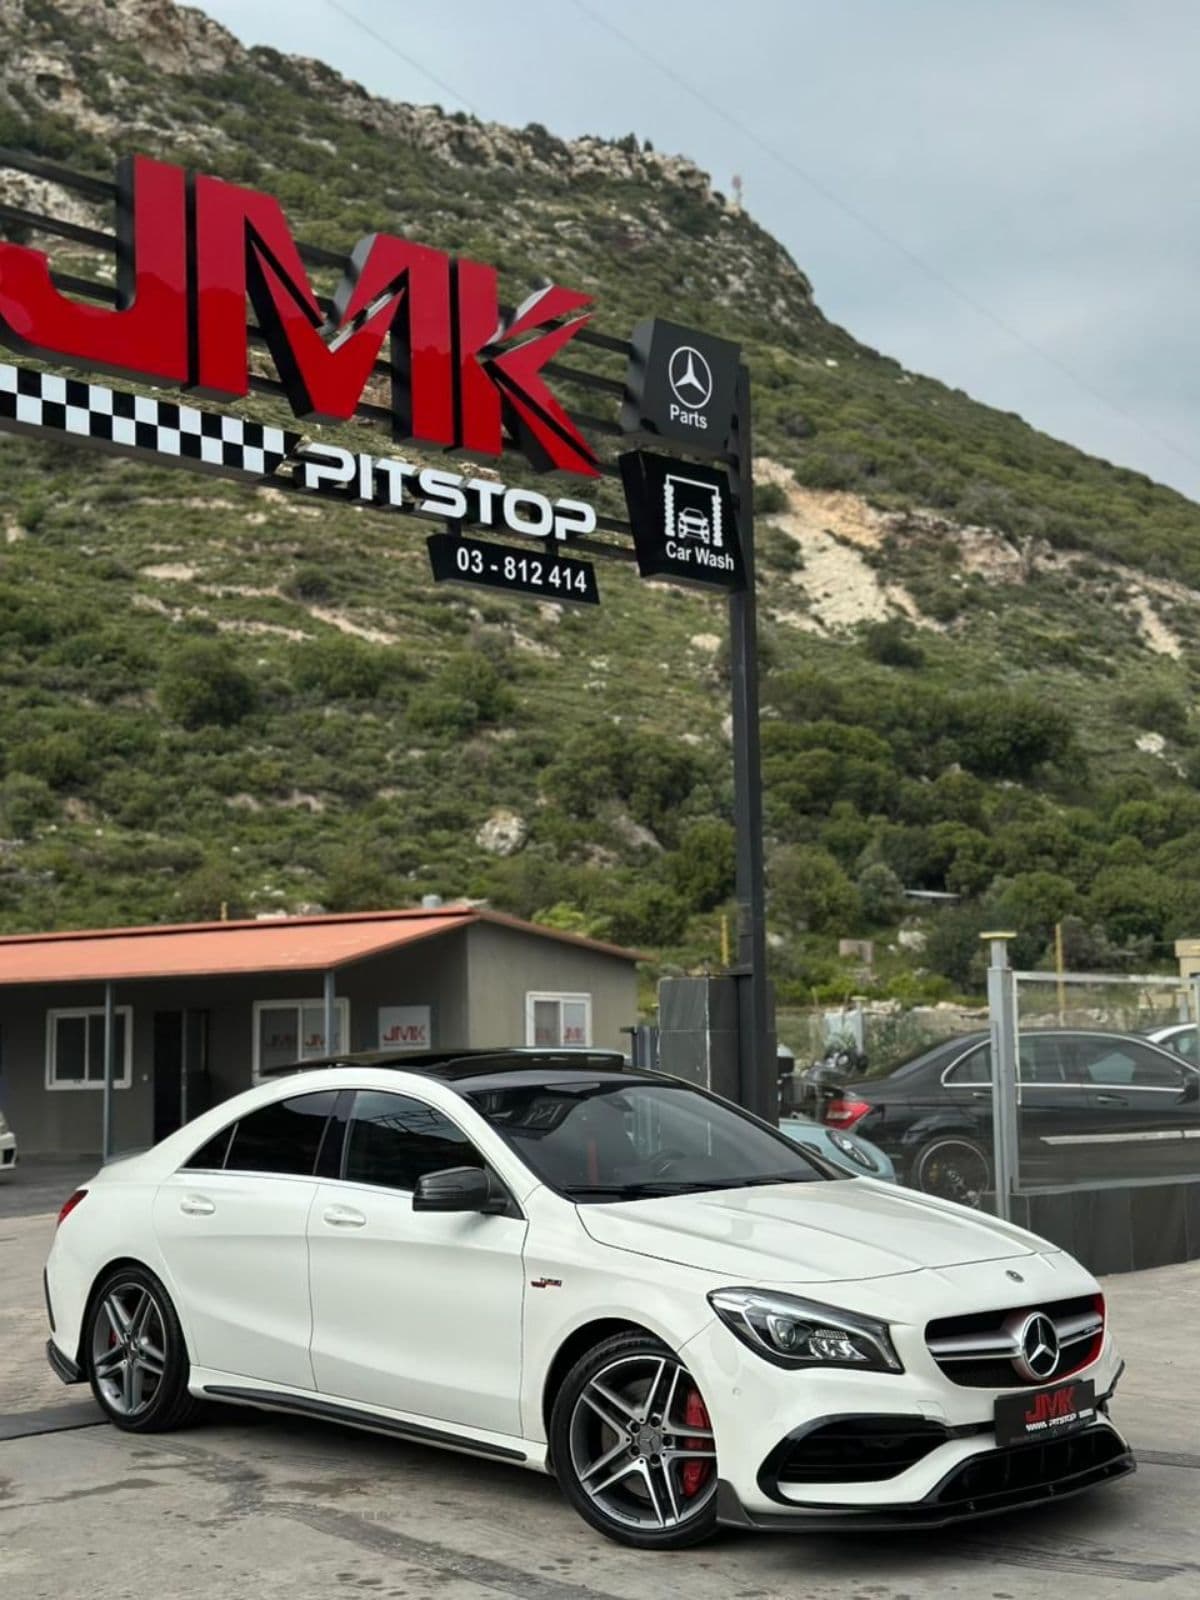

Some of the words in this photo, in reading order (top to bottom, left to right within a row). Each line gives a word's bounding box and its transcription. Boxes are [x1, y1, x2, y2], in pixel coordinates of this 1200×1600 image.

[0, 154, 599, 477] JMK
[669, 403, 708, 429] Parts
[303, 442, 597, 540] PITSTOP
[456, 546, 483, 573] 03
[504, 556, 543, 585] 812
[548, 565, 587, 593] 414
[665, 540, 692, 561] Car
[694, 547, 735, 571] Wash
[383, 1024, 426, 1041] JMK
[1025, 1386, 1075, 1423] JMK
